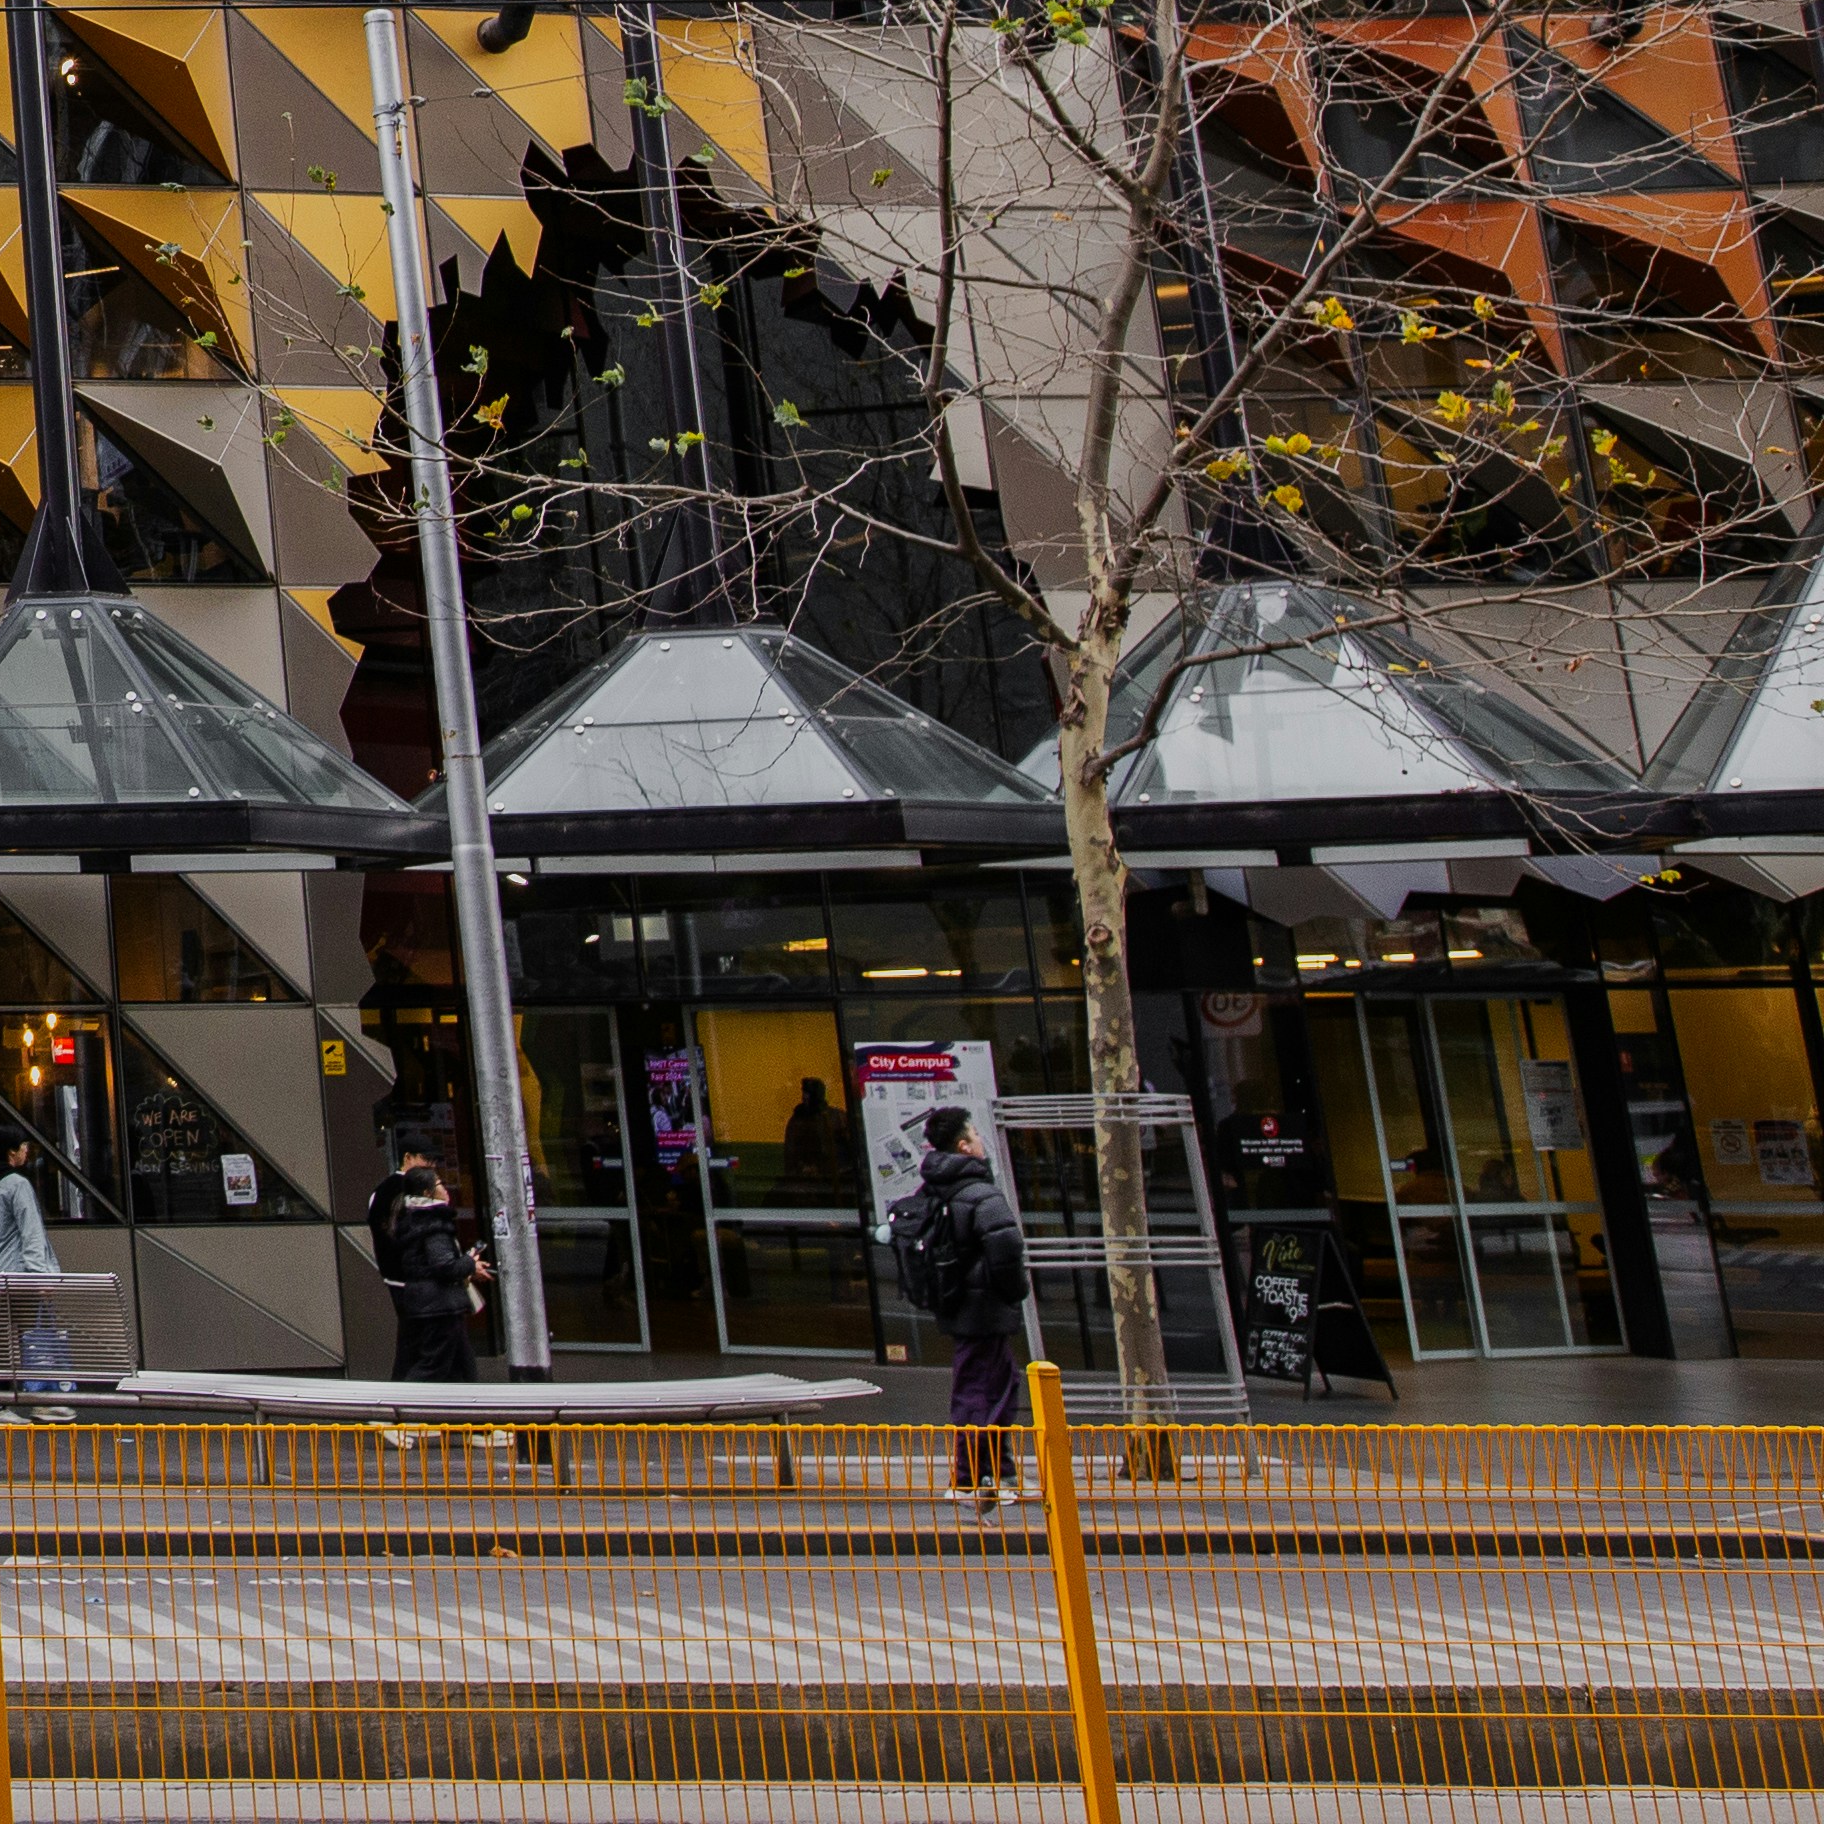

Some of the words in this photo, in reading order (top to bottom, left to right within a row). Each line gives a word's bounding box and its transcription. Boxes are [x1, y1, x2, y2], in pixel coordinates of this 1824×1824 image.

[870, 1056, 895, 1070] City
[898, 1056, 951, 1069] Campus
[142, 1110, 164, 1127] WE
[169, 1109, 198, 1126] ARE
[150, 1128, 200, 1149] OPEN
[1255, 1275, 1299, 1291] COFFEE
